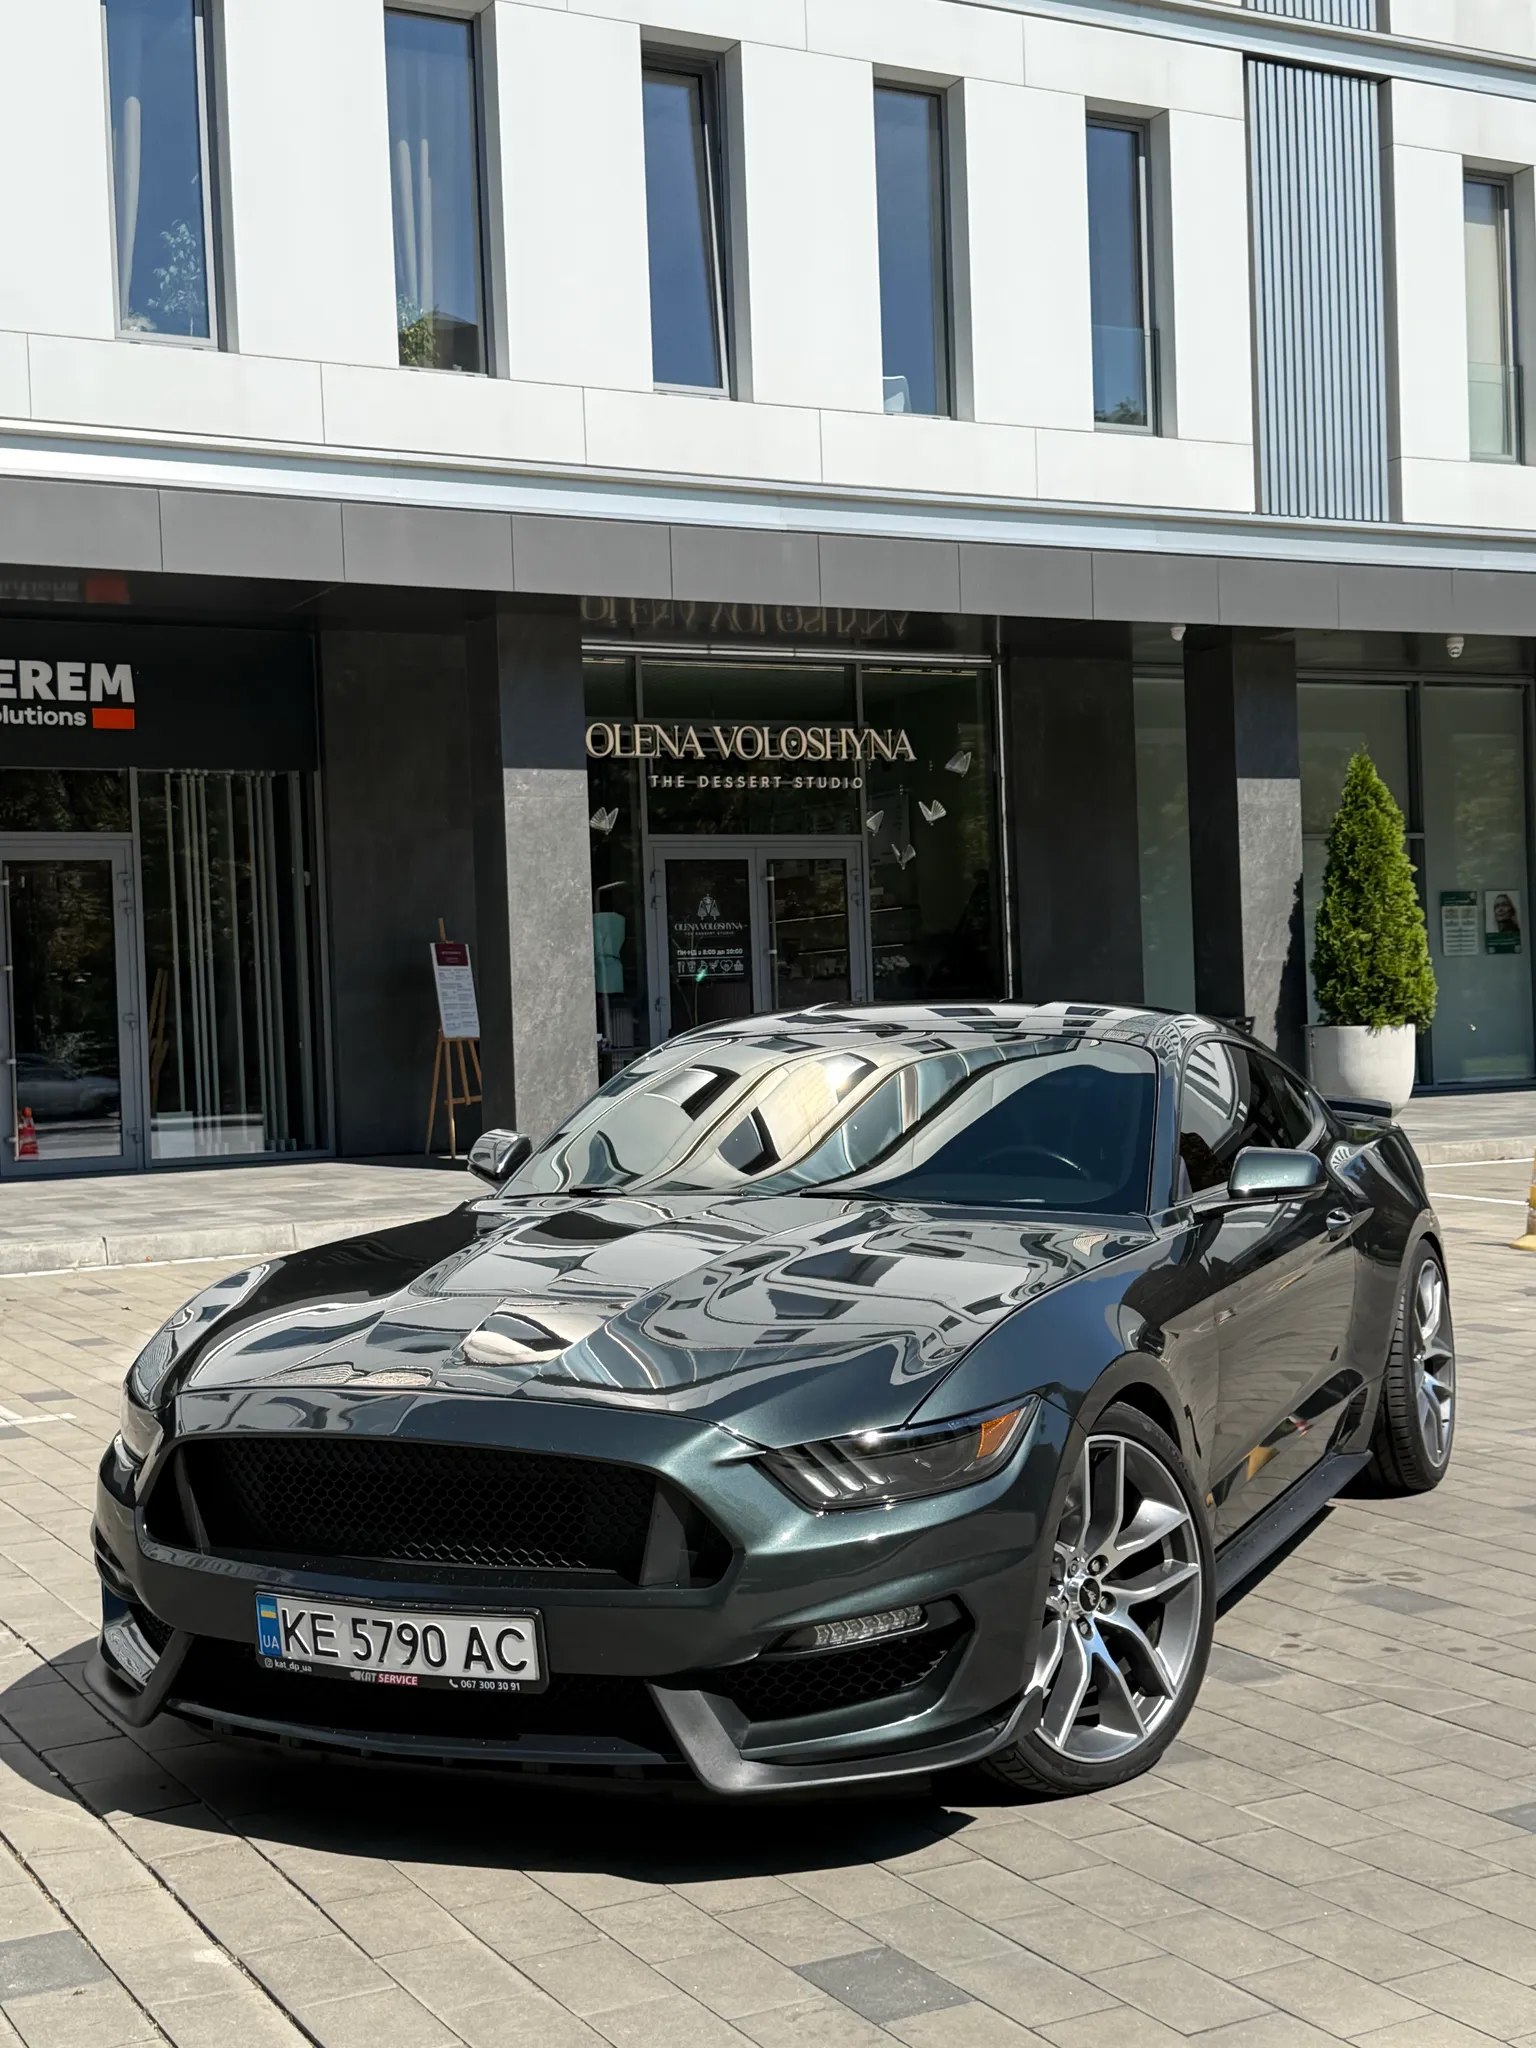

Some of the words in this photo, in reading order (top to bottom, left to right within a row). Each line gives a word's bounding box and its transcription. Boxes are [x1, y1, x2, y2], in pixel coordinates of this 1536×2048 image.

[0, 705, 87, 726] lutions
[585, 722, 706, 760] OLENA
[711, 726, 916, 761] VOLOSHYNA
[651, 775, 686, 788] THE
[699, 776, 782, 789] DESSERT
[796, 776, 864, 790] STUDIO
[263, 1634, 280, 1650] UA
[281, 1608, 340, 1659] KE
[351, 1617, 448, 1669] 5790
[462, 1625, 529, 1673] AC
[378, 1673, 418, 1686] SERVICE
[460, 1679, 476, 1689] 067
[479, 1680, 496, 1690] 300
[497, 1681, 509, 1691] 30
[510, 1682, 521, 1691] 91
